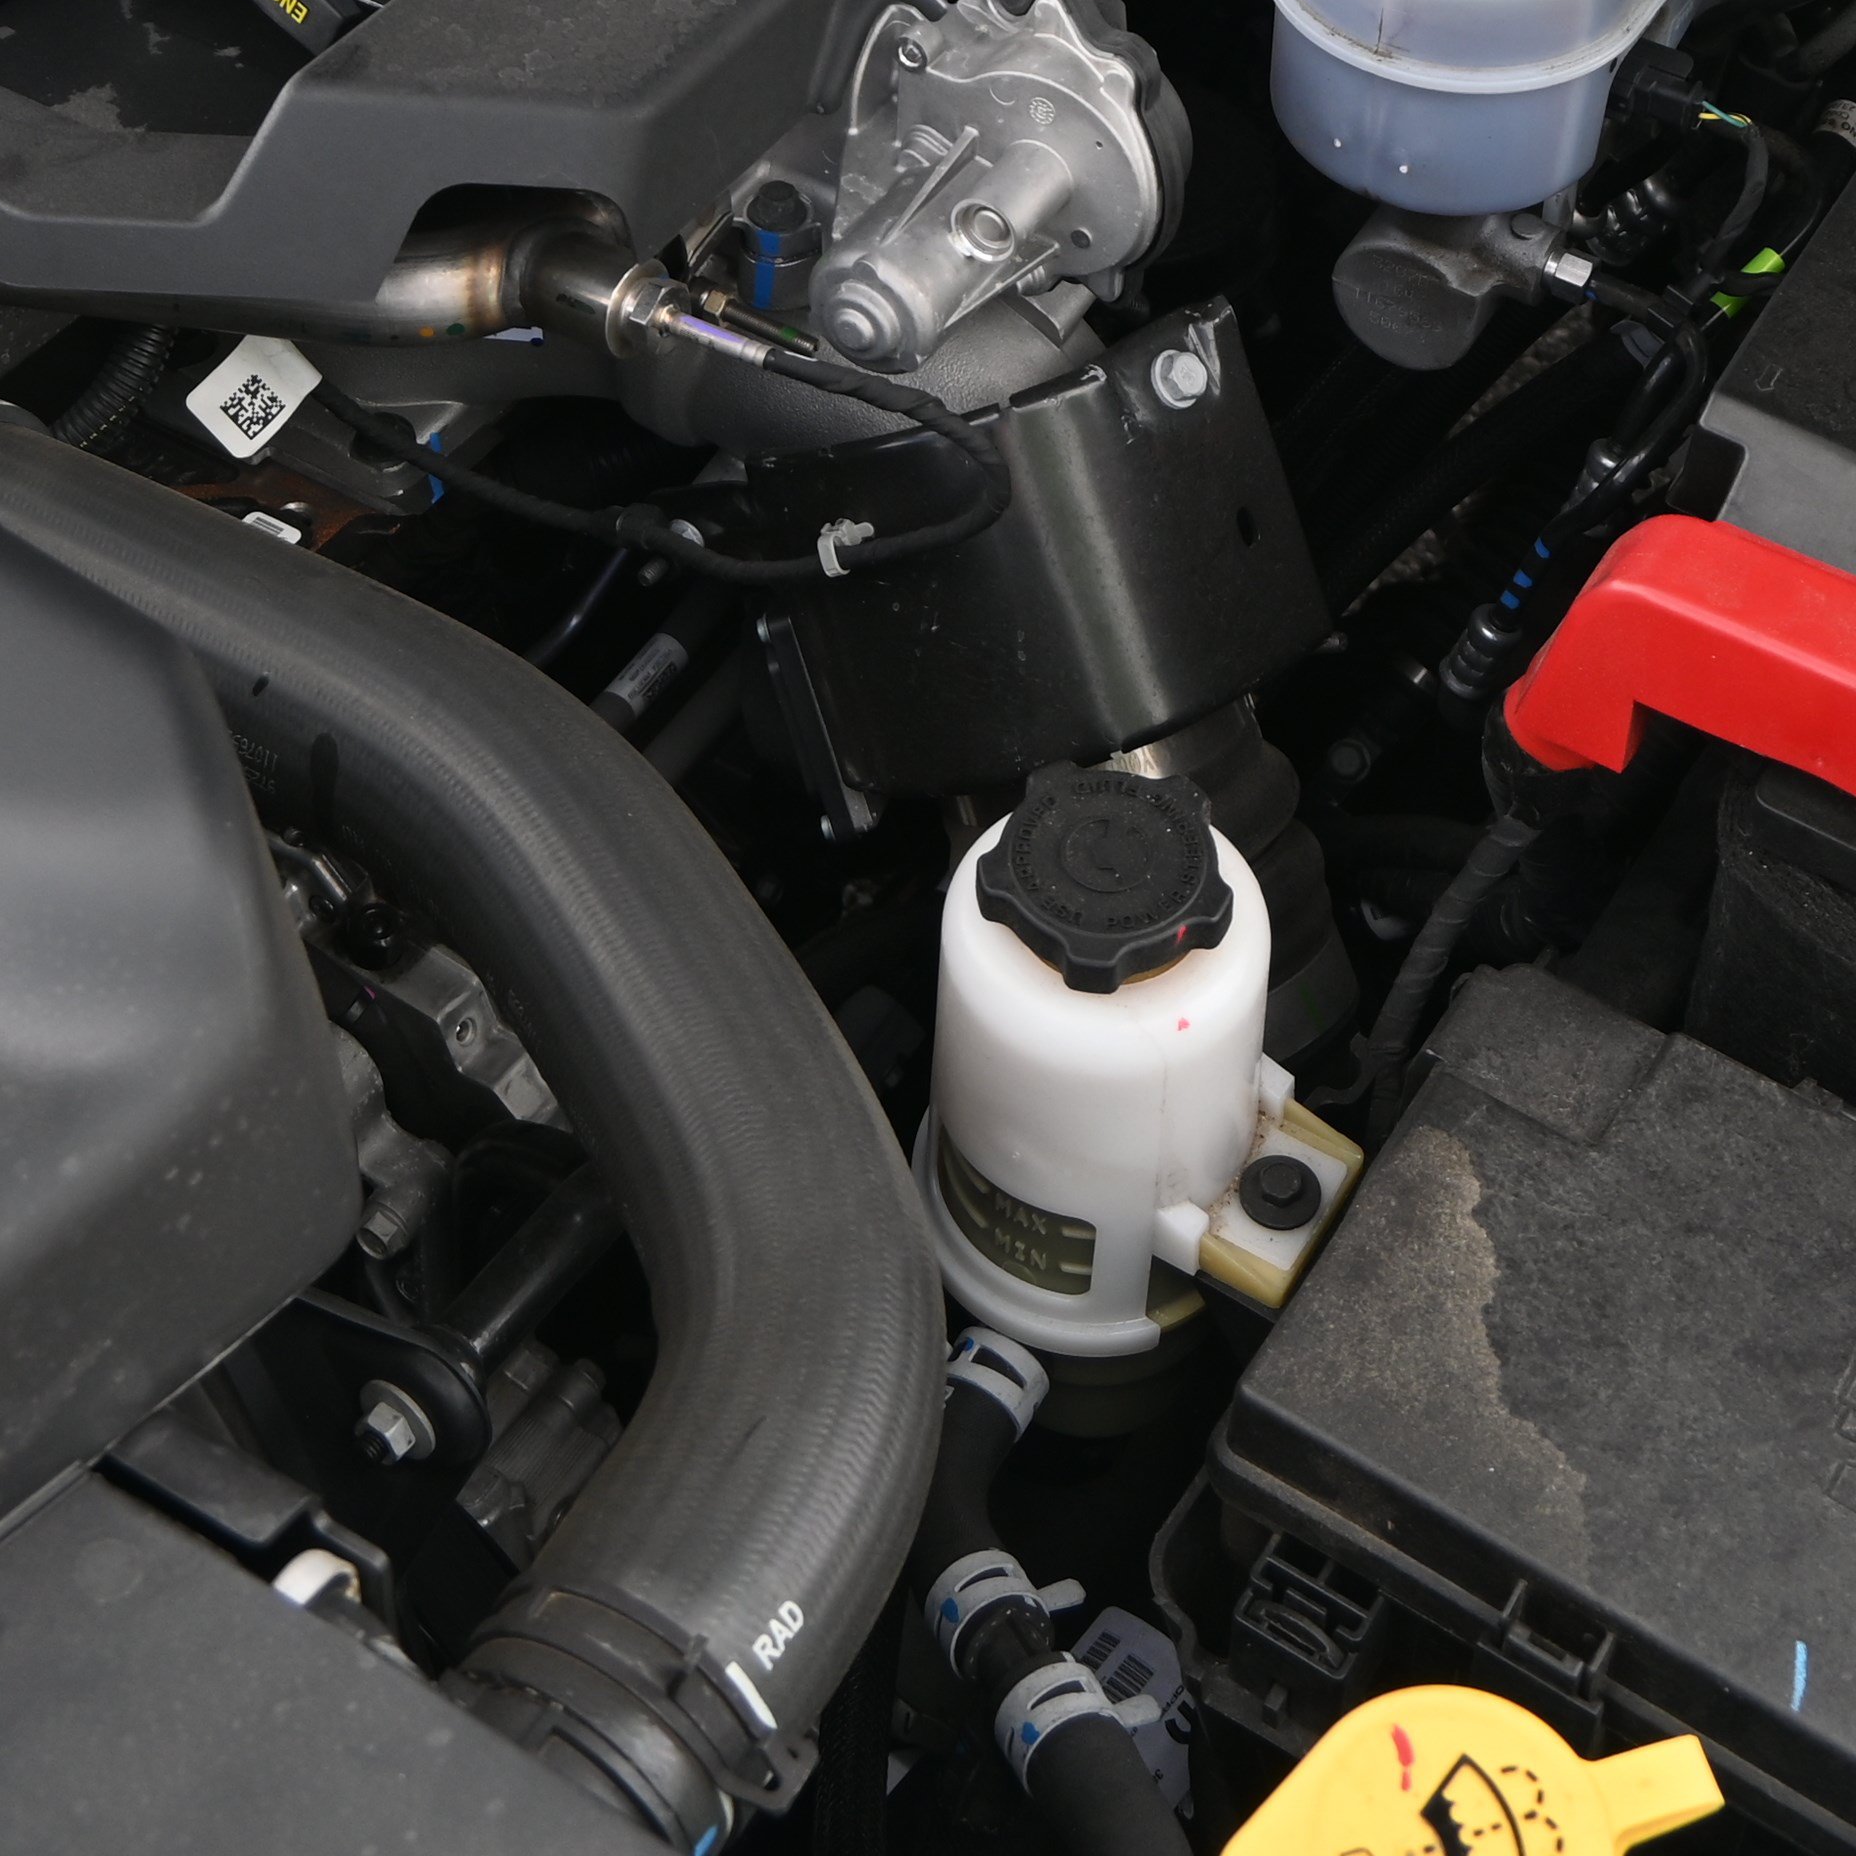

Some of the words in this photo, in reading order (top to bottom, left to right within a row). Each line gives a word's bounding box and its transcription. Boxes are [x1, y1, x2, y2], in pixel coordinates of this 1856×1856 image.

[1015, 795, 1058, 892] APPROVED
[1040, 896, 1083, 927] USE
[1106, 890, 1187, 930] POWER
[995, 1193, 1046, 1235] MAX
[994, 1227, 1047, 1271] MIN
[751, 1599, 804, 1672] RAD
